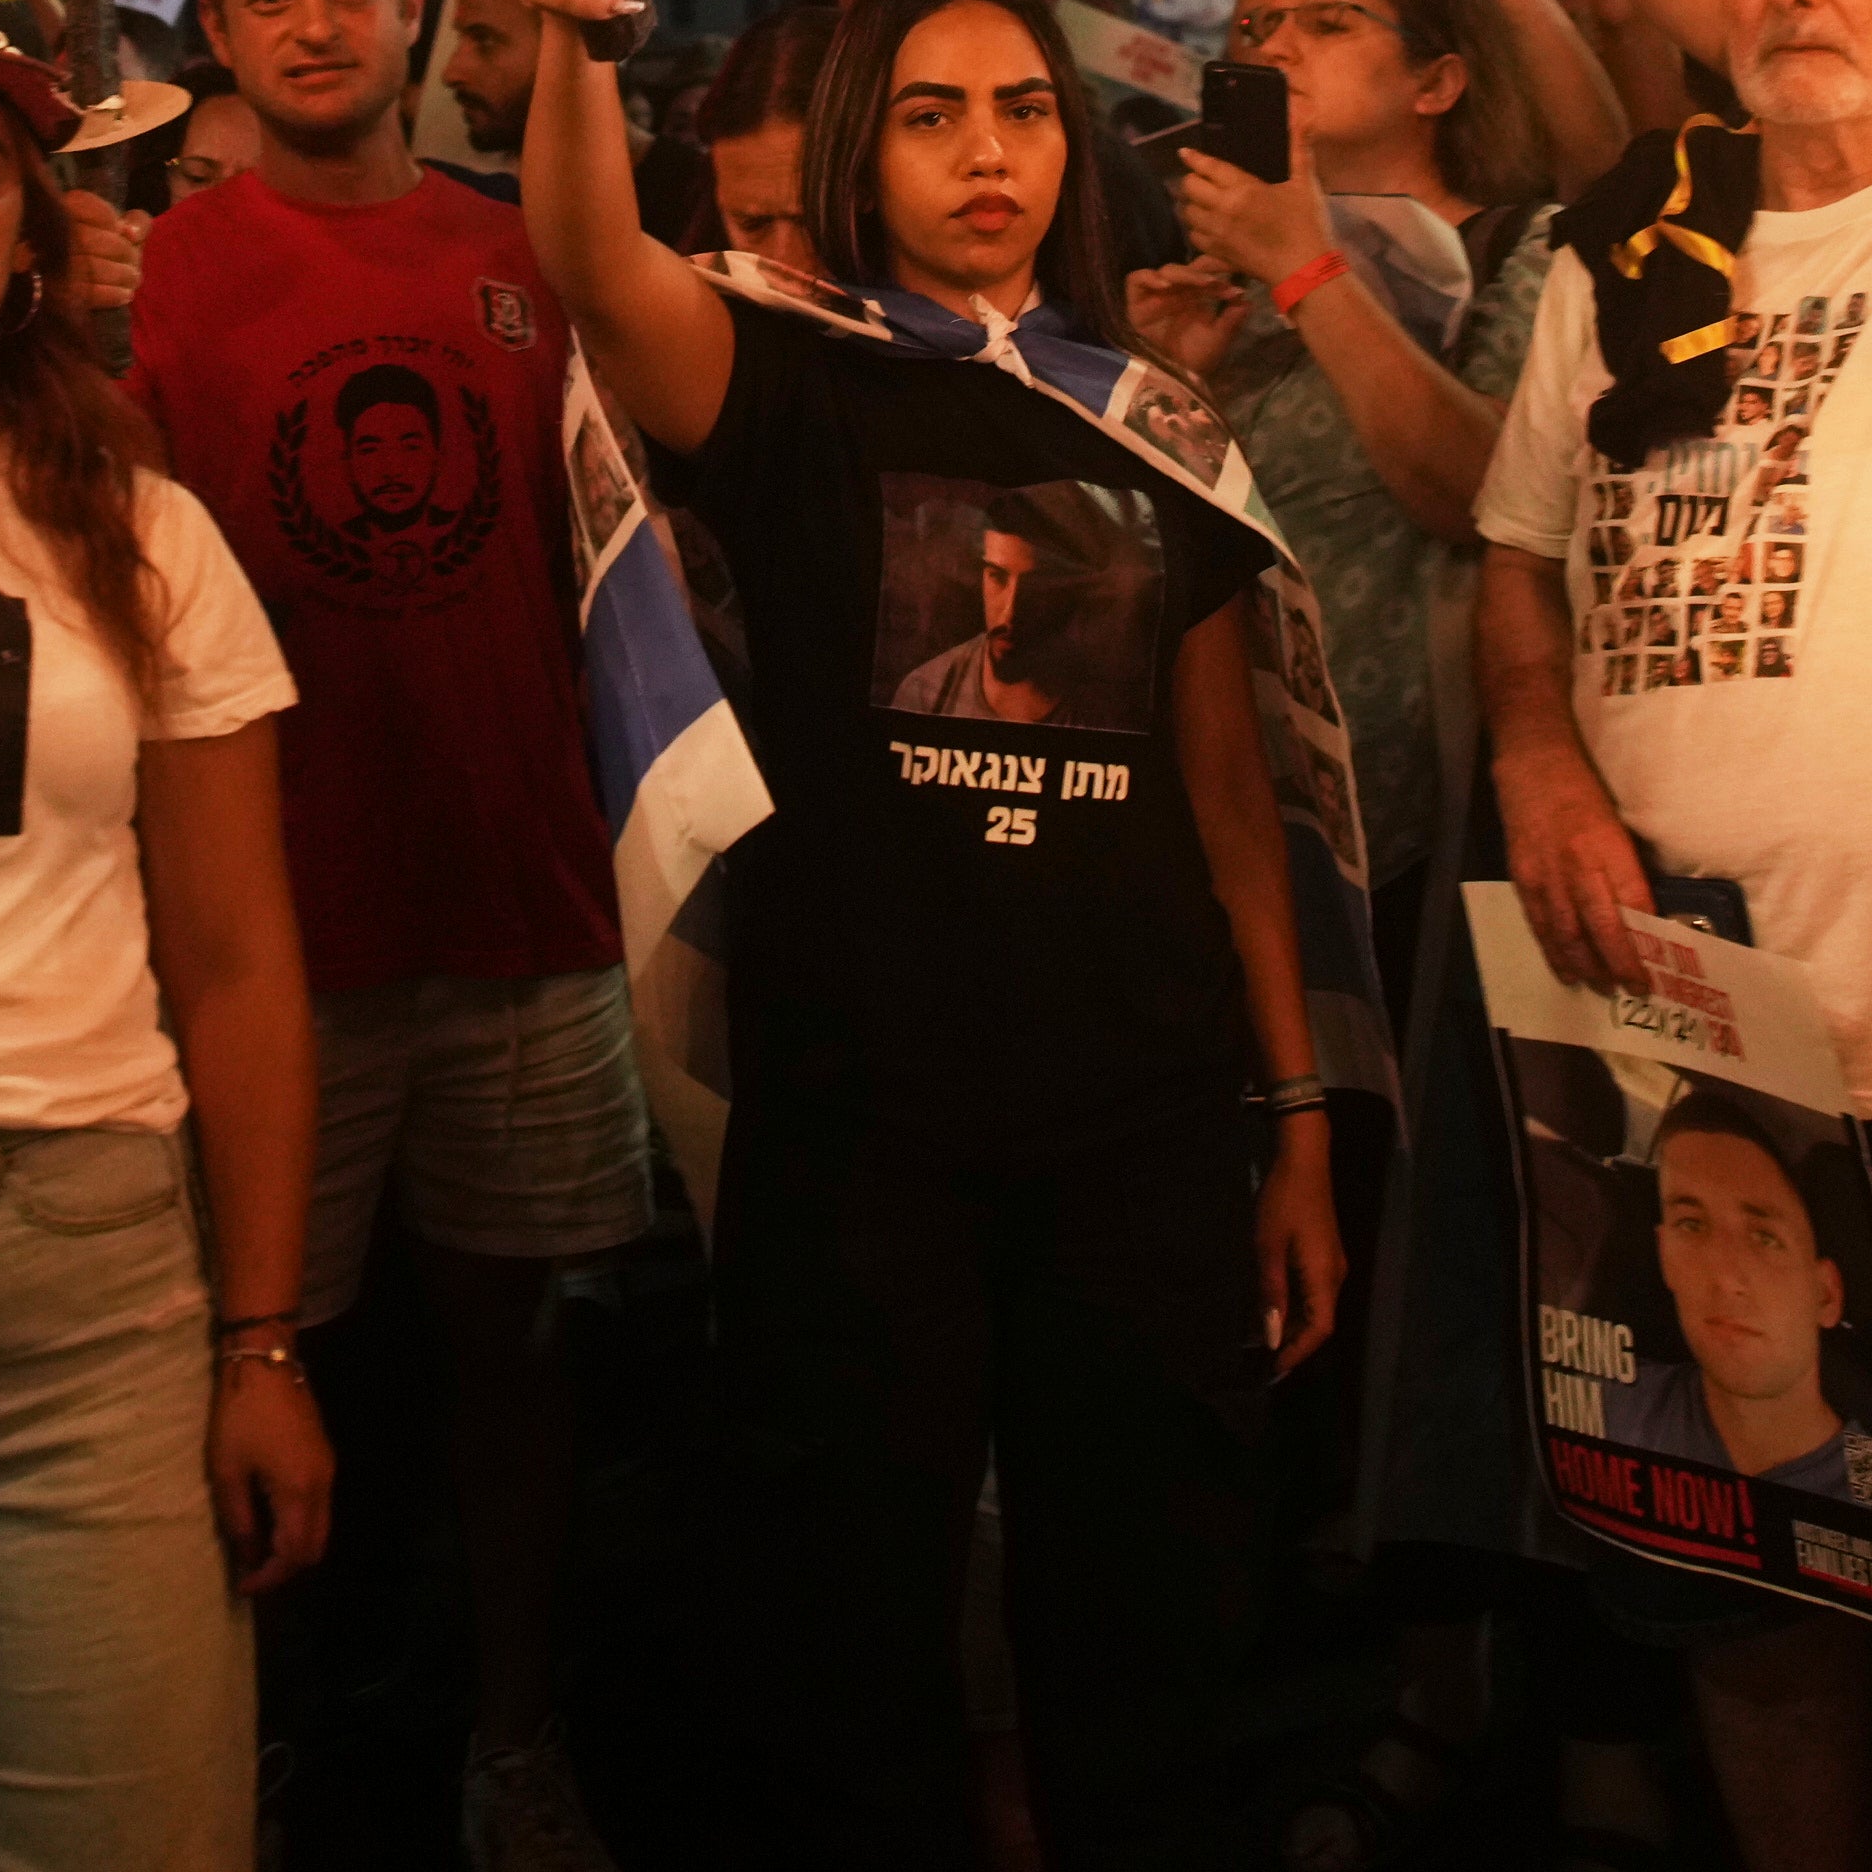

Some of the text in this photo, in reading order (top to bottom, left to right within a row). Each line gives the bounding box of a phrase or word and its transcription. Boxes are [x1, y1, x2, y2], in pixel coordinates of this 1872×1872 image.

[889, 740, 1130, 802] מתן צנגאוקר
[984, 805, 1038, 846] 25
[1538, 1303, 1638, 1386] BRING
[1542, 1367, 1608, 1441] HIM
[1548, 1436, 1758, 1546] HOME NOW!
